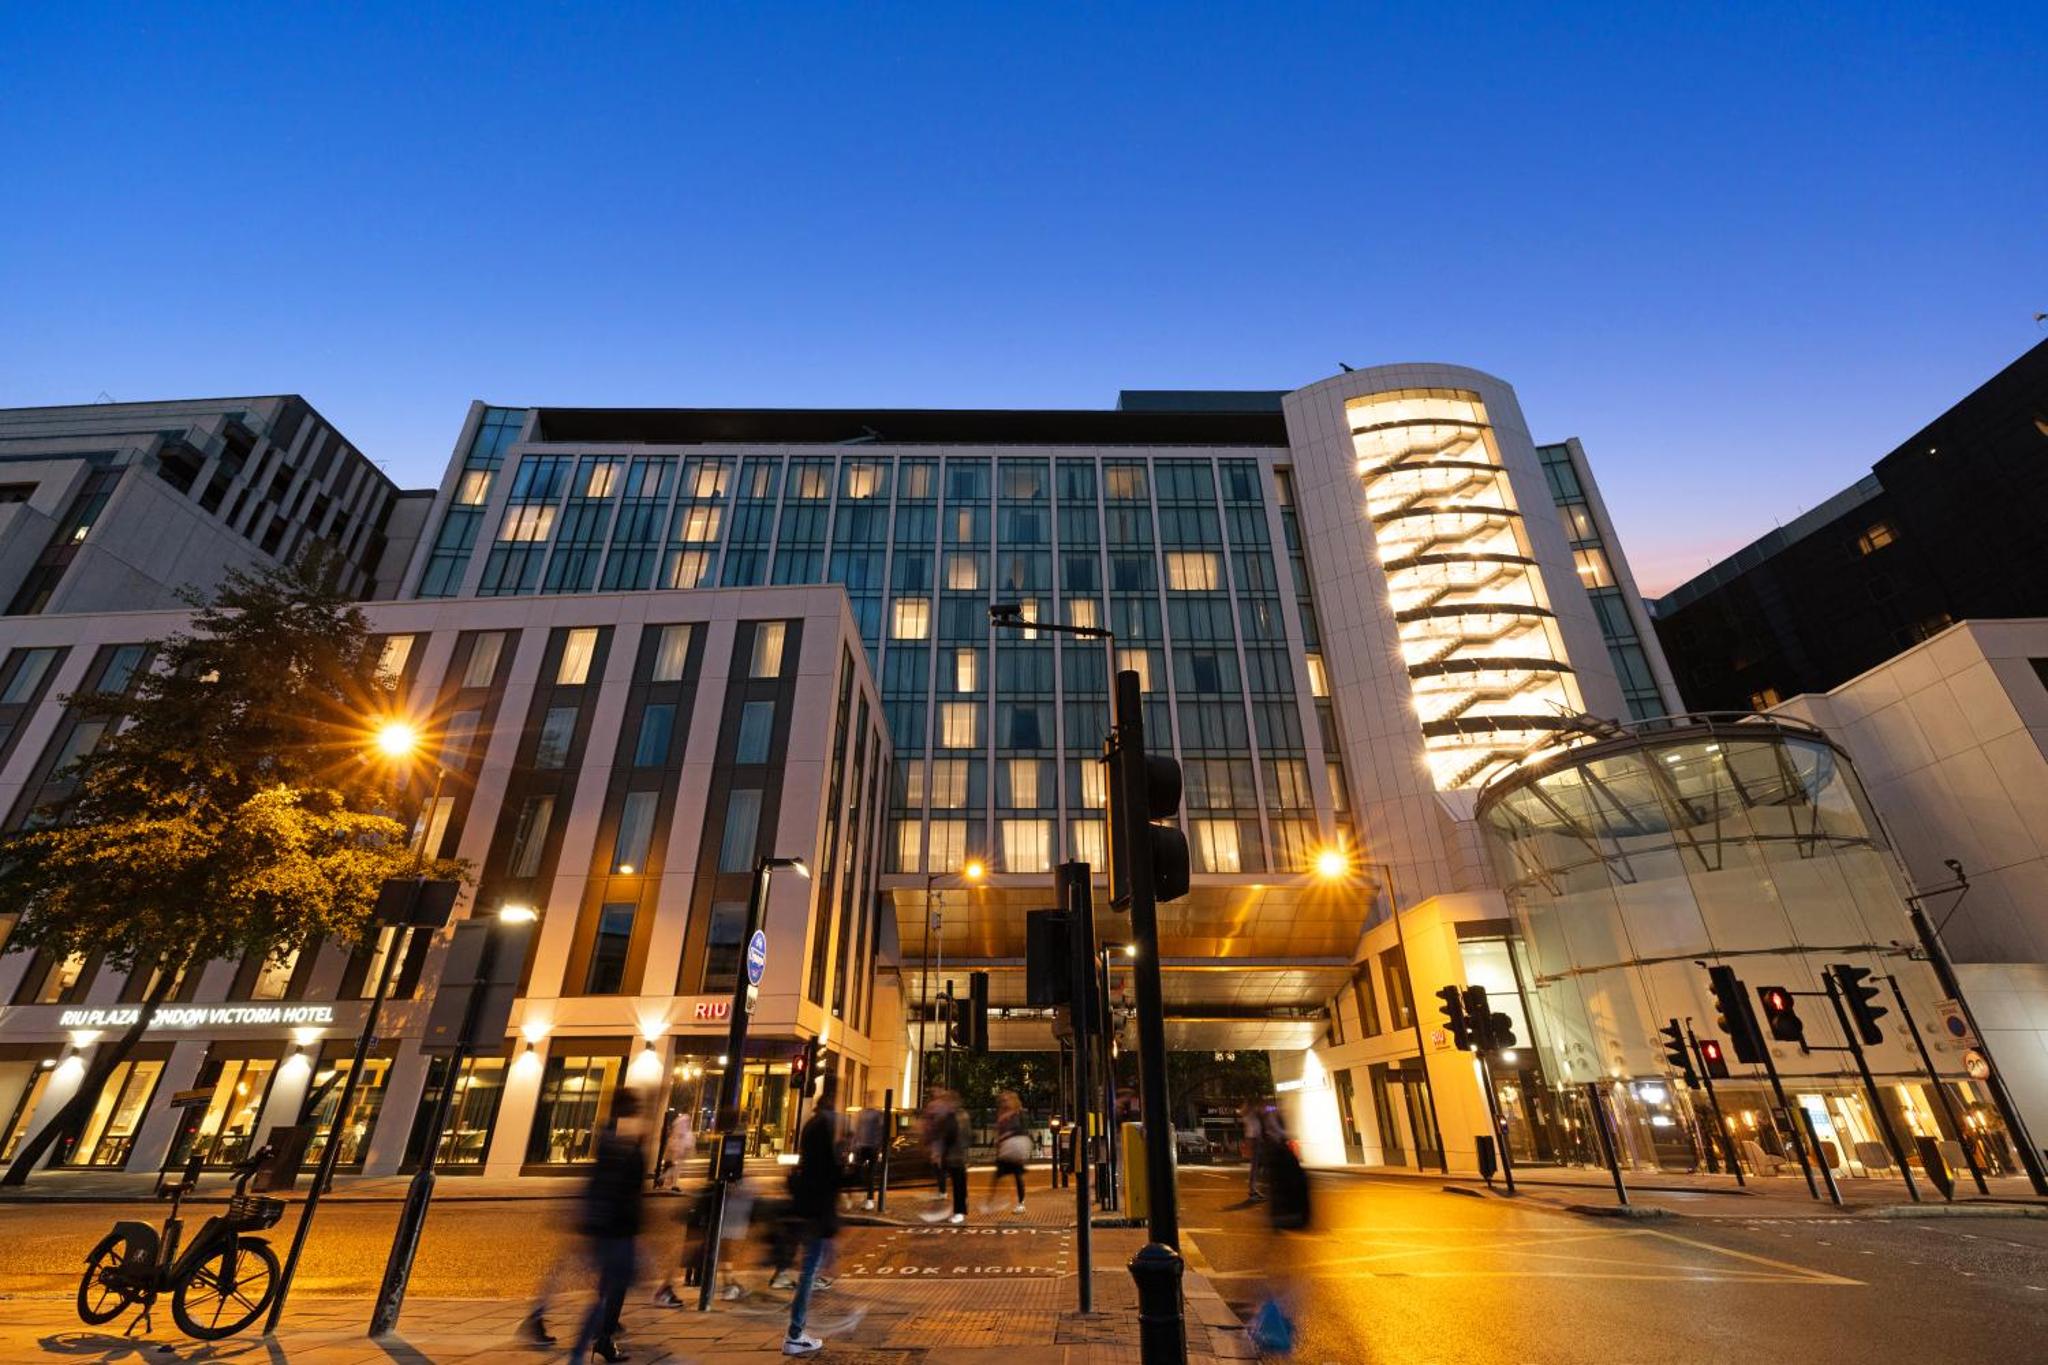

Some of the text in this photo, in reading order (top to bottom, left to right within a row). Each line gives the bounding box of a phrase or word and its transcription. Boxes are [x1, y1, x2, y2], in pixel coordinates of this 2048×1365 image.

[60, 1006, 333, 1025] RIU PLAZA ONDON VICTORIA HOTEL
[694, 1002, 727, 1017] RIU
[853, 1265, 1036, 1275] LOOK RIGHT
